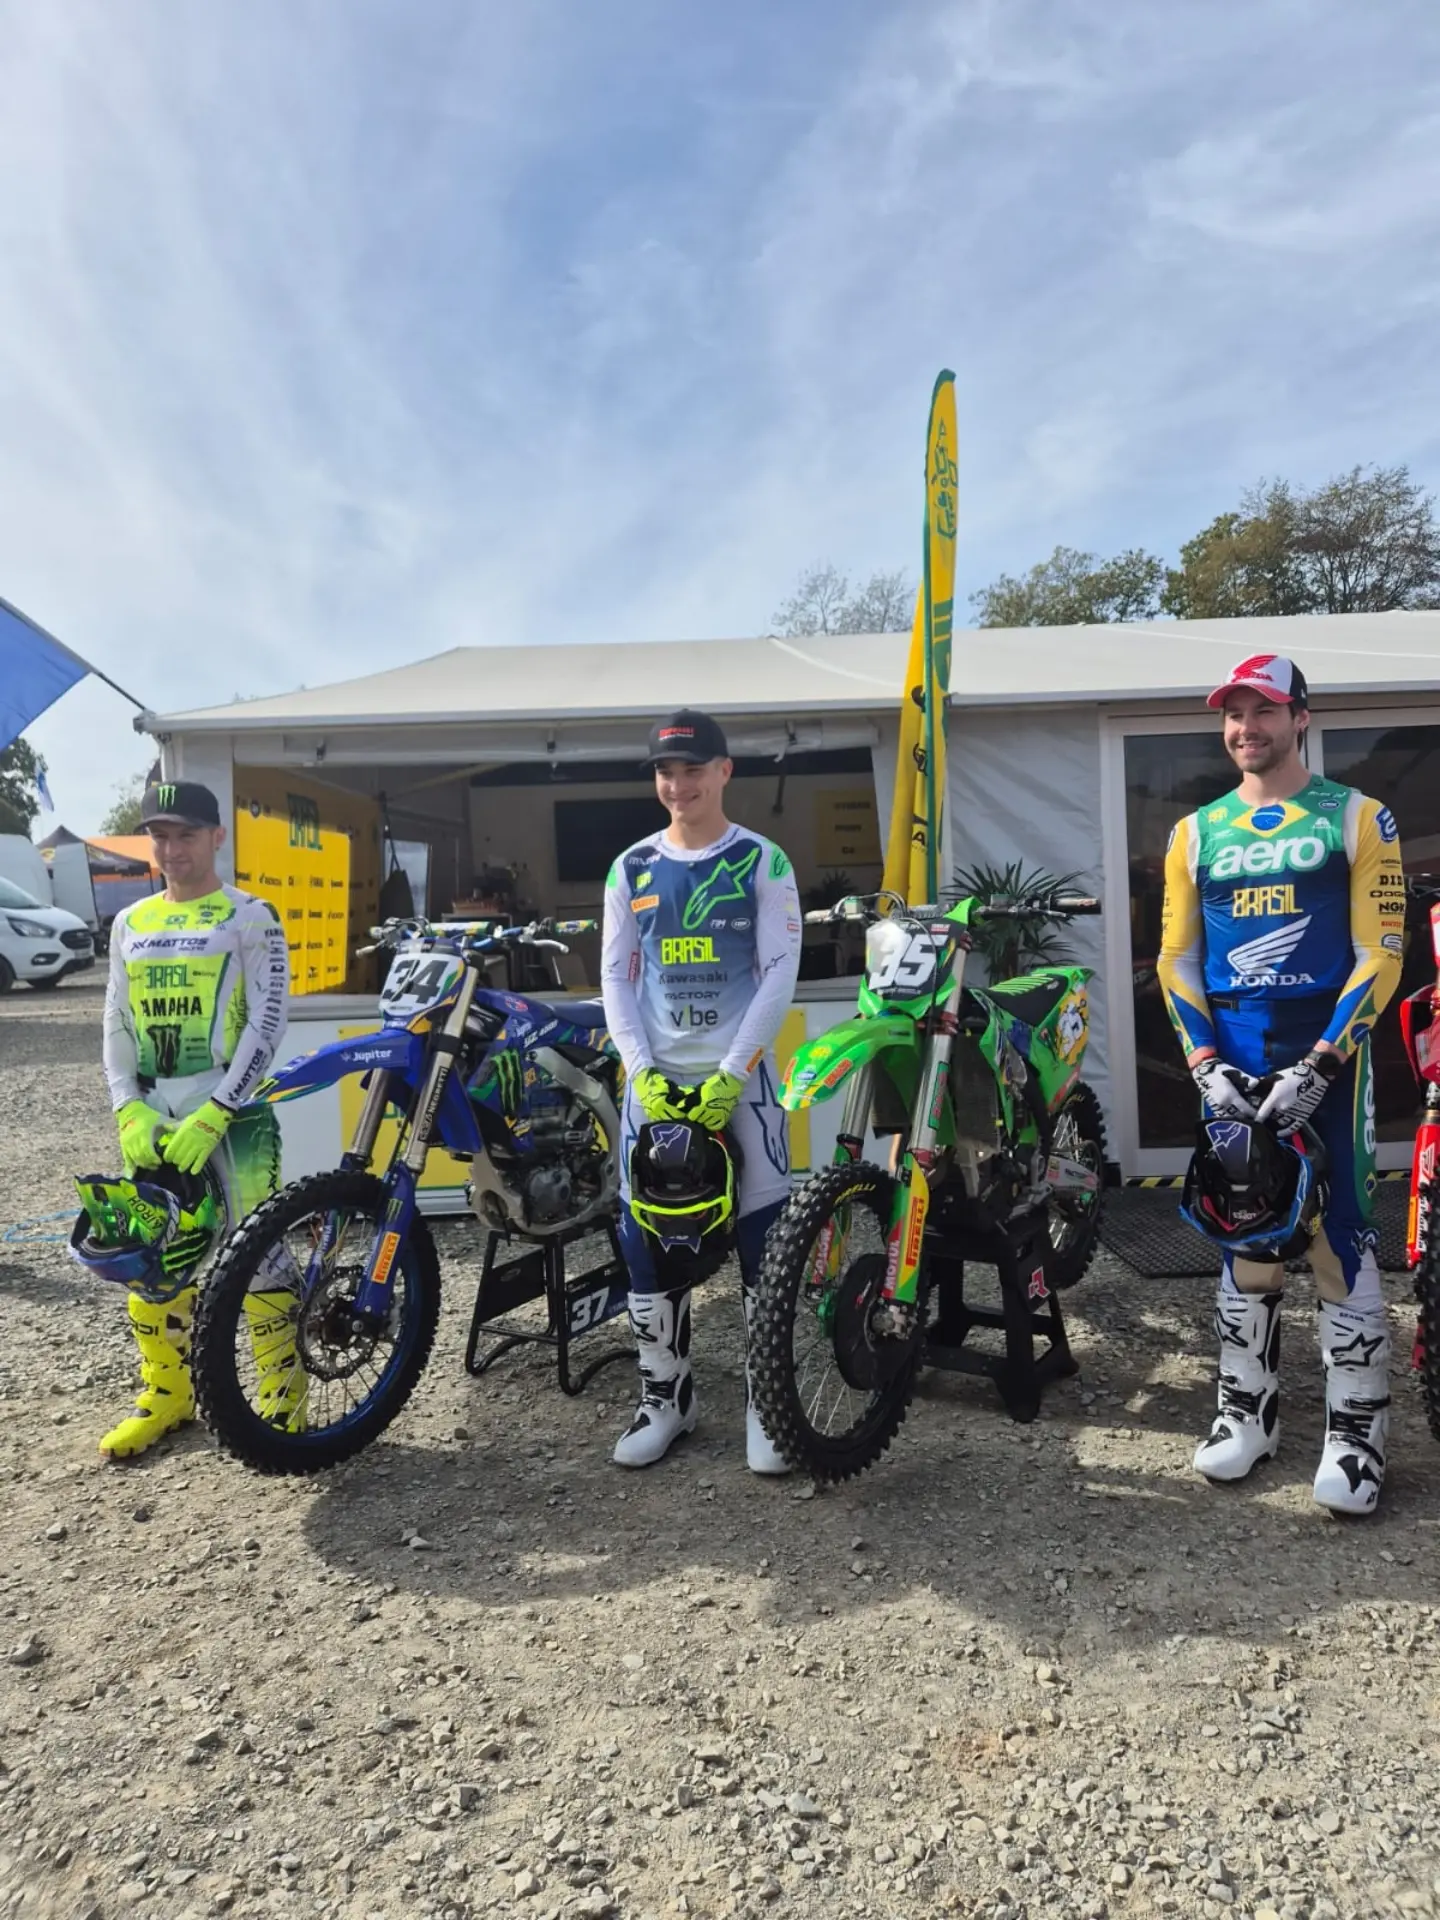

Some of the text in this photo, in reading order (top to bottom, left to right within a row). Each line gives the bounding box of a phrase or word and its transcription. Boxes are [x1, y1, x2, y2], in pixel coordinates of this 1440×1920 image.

[1213, 836, 1325, 877] aero
[1232, 884, 1303, 918] BRASIL
[662, 937, 720, 966] BRASIL
[382, 960, 449, 1003] 34
[659, 970, 728, 985] Kawasaki
[1230, 972, 1315, 987] HONDA
[664, 991, 721, 1000] FACTORY
[353, 1050, 392, 1063] Jupiter
[884, 1240, 900, 1289] MOTUL
[571, 1286, 610, 1332] 37
